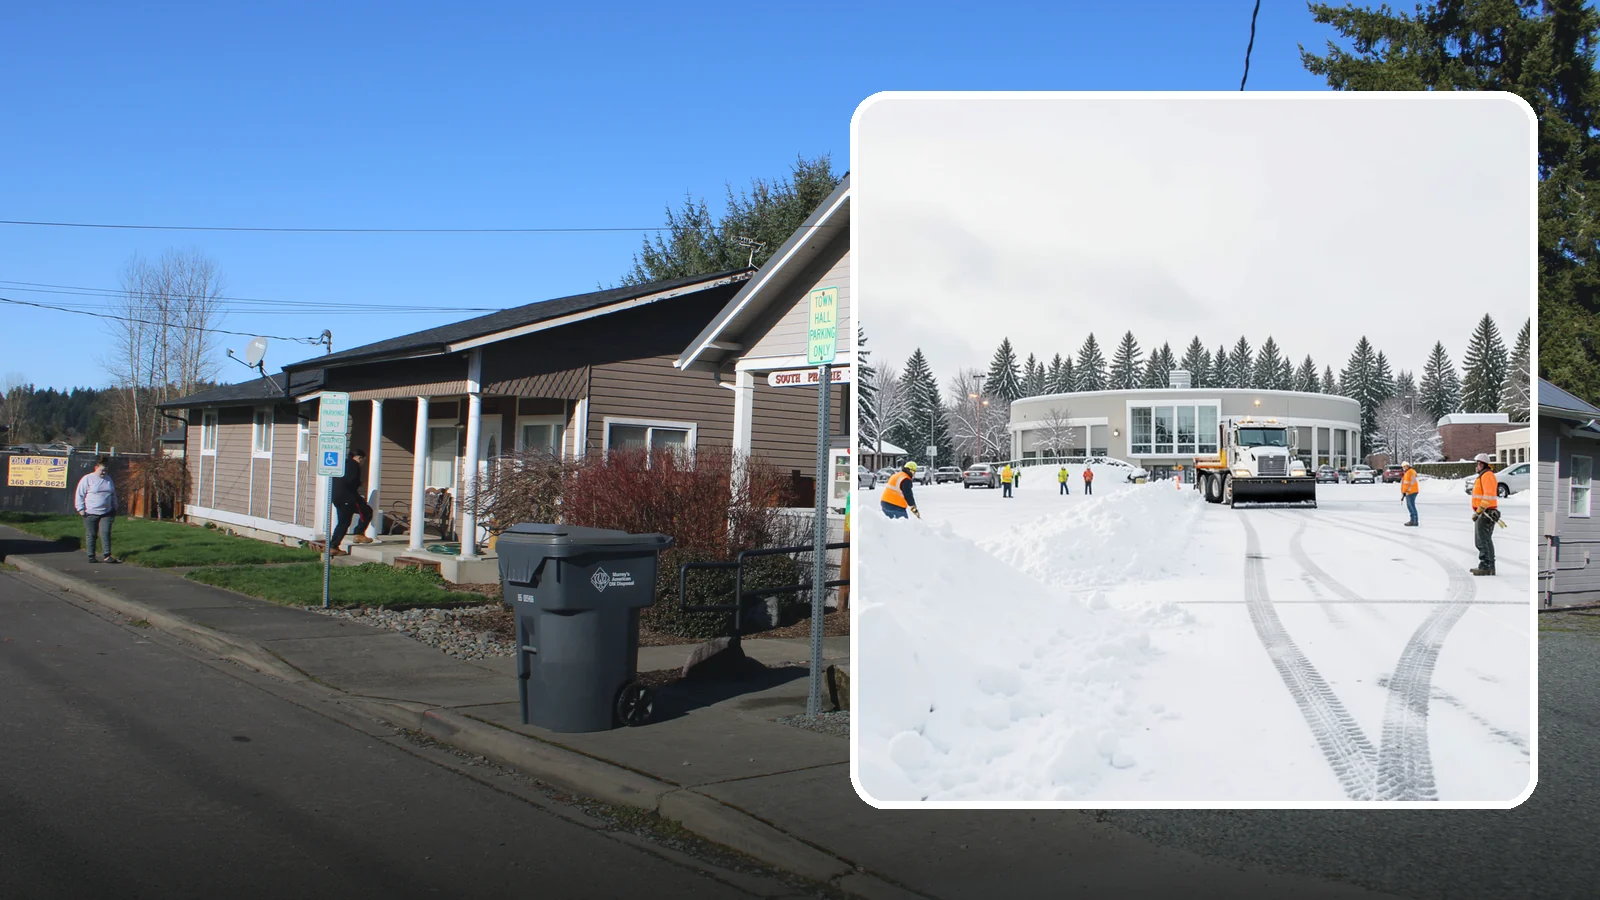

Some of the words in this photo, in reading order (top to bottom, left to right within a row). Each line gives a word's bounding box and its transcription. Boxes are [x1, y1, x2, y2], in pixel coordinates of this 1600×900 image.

[815, 295, 833, 308] TOWN
[814, 311, 831, 324] HALL
[810, 327, 836, 340] PARKING
[814, 344, 831, 357] ONLY
[776, 374, 801, 384] SOUTH
